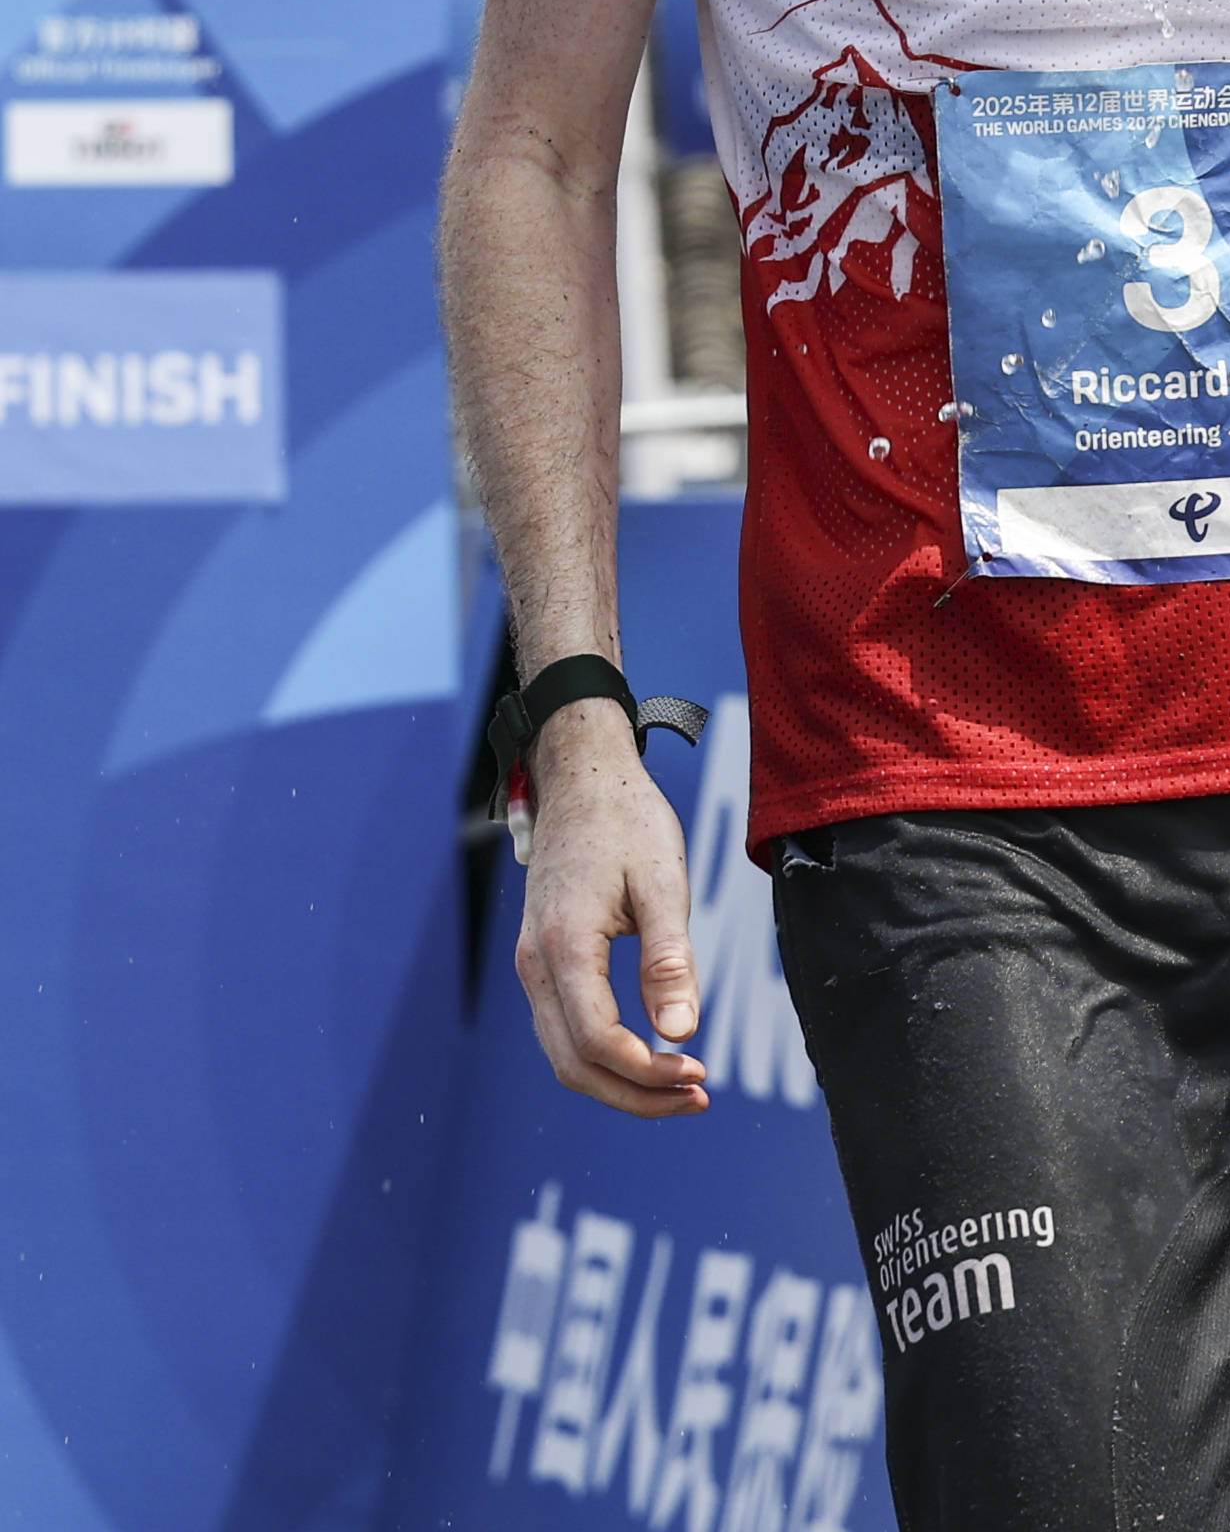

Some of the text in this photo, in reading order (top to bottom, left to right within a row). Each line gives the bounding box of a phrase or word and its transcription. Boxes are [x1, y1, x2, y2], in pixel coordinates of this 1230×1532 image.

[973, 121, 1004, 137] THE
[1006, 119, 1064, 136] WORLD
[1069, 117, 1123, 133] GAMES
[1128, 115, 1166, 132] 2025
[0, 350, 261, 427] FINISH
[1075, 423, 1222, 451] Orienteering
[873, 1207, 924, 1264] swiss
[879, 1205, 1055, 1292] orienteering
